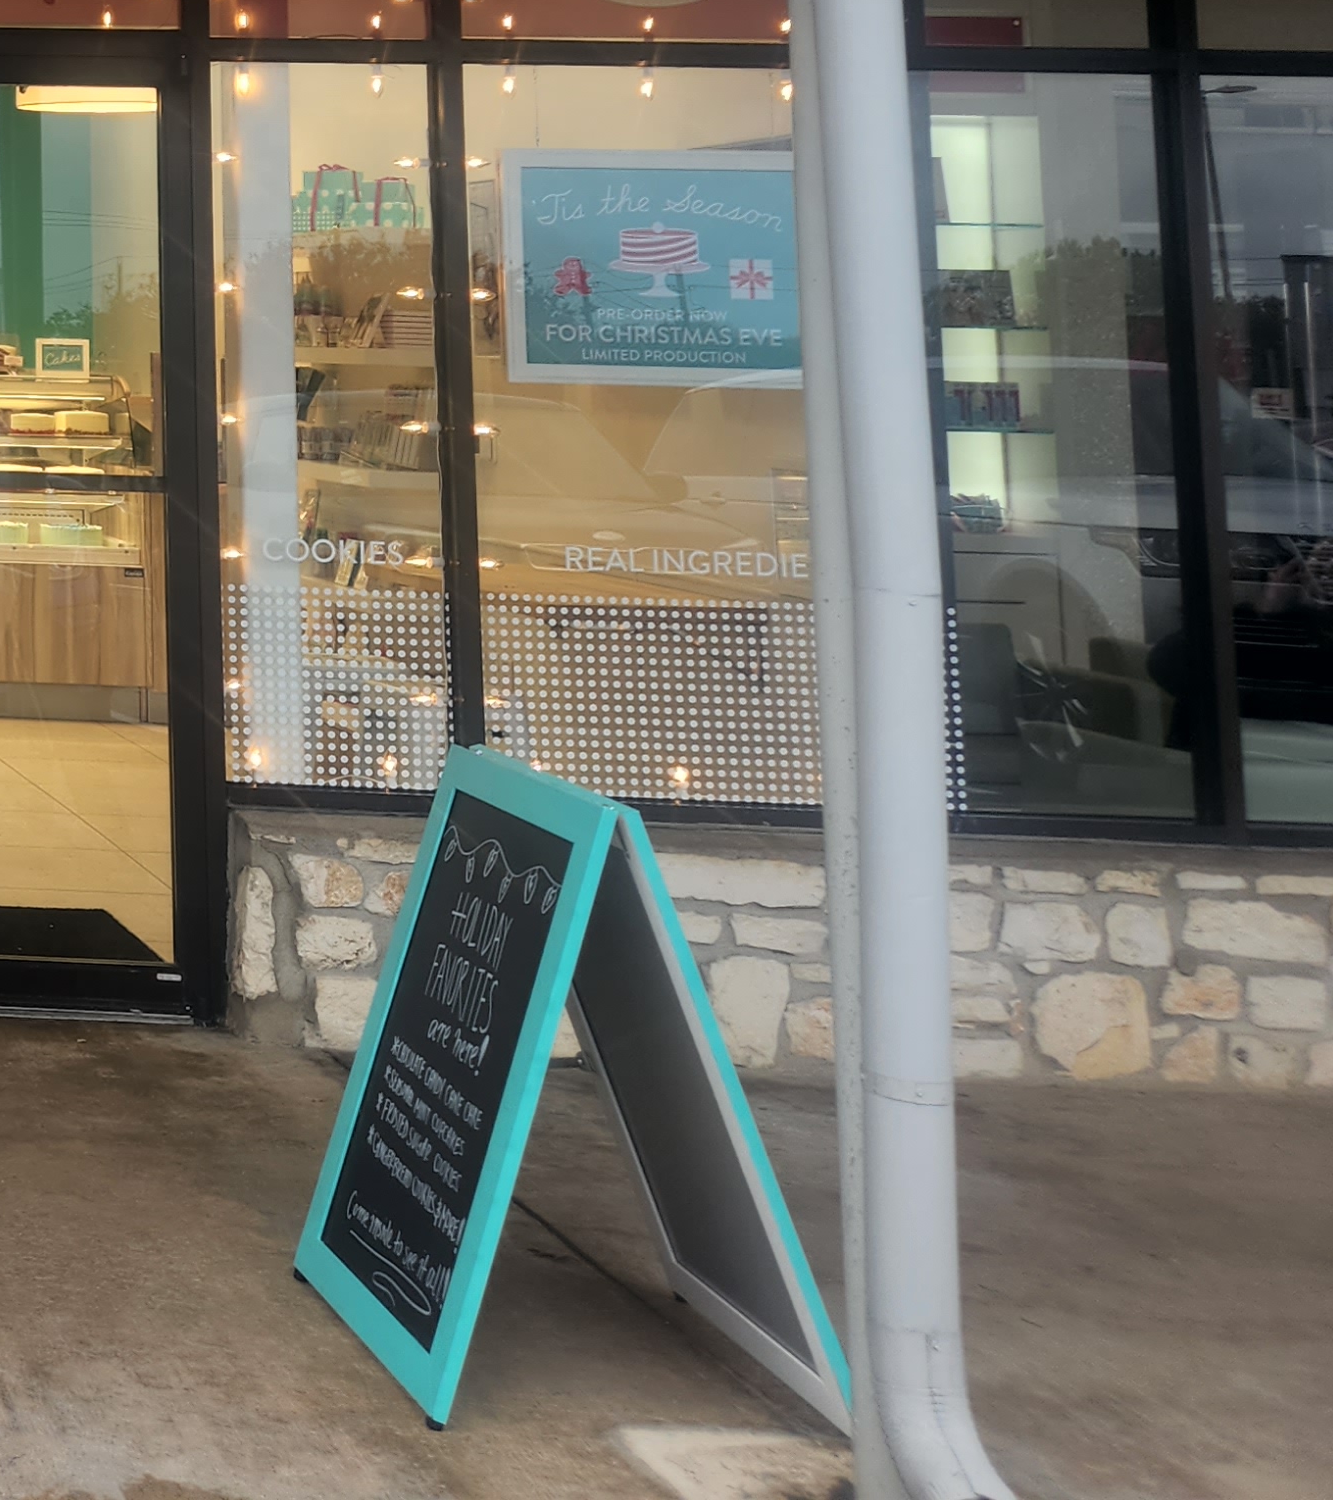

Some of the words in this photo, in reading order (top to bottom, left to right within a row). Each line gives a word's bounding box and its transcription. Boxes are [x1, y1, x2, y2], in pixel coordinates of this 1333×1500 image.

[596, 184, 650, 216] the
[662, 184, 784, 232] Season
[596, 308, 684, 323] PRE-ORDER
[689, 309, 728, 323] NOW
[545, 323, 592, 343] FOR
[598, 325, 732, 346] CHRISTMAS
[738, 328, 783, 347] EVE
[582, 348, 641, 362] LIMITED
[644, 350, 746, 364] PRODUCTION
[262, 537, 404, 567] COOKIES
[564, 545, 642, 573] REAL
[652, 547, 809, 579] INGREDIE
[449, 891, 514, 972] HOLIDAY
[424, 943, 499, 1034] FAVORITES
[427, 1018, 452, 1049] are
[452, 1027, 490, 1077] here!
